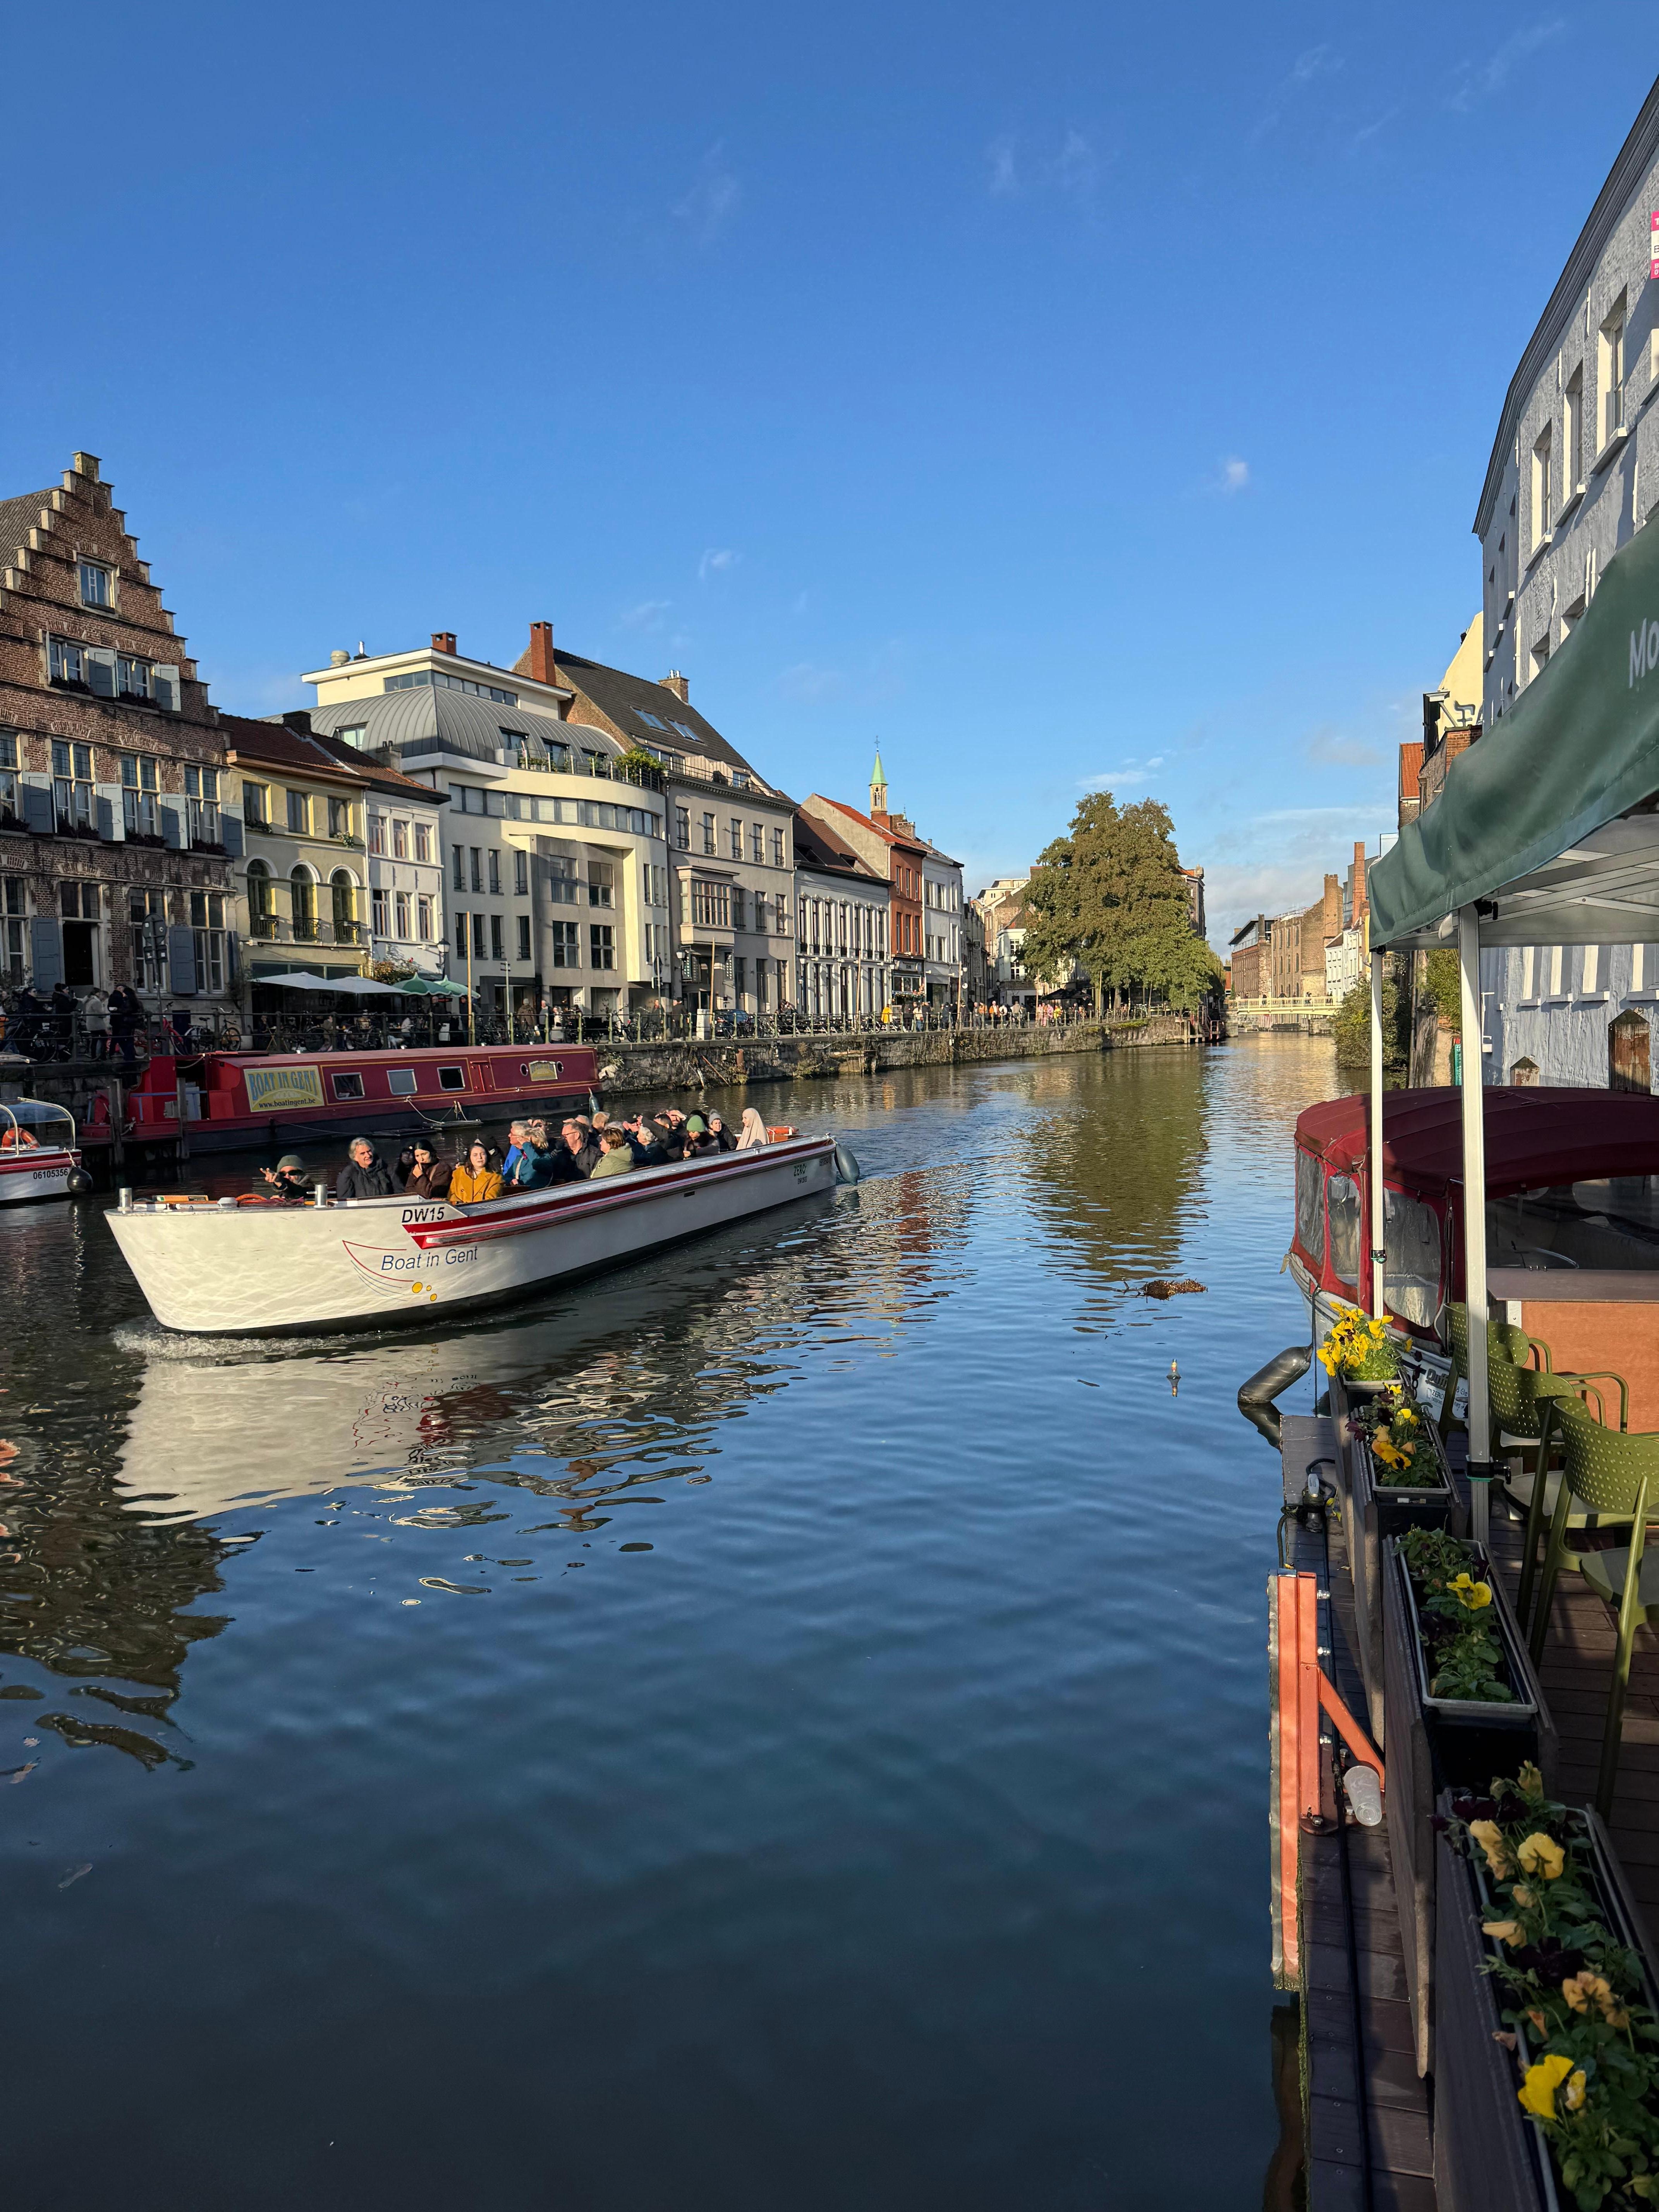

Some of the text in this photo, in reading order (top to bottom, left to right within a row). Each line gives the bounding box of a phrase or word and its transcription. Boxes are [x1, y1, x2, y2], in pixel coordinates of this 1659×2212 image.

[248, 1070, 318, 1101] BOAT IN GENT
[259, 1098, 316, 1108] www.boatingent.be
[33, 1168, 68, 1179] 06105356
[402, 1207, 445, 1223] DW15
[381, 1246, 477, 1271] Boat in Gent
[1432, 1389, 1444, 1400] ZERO
